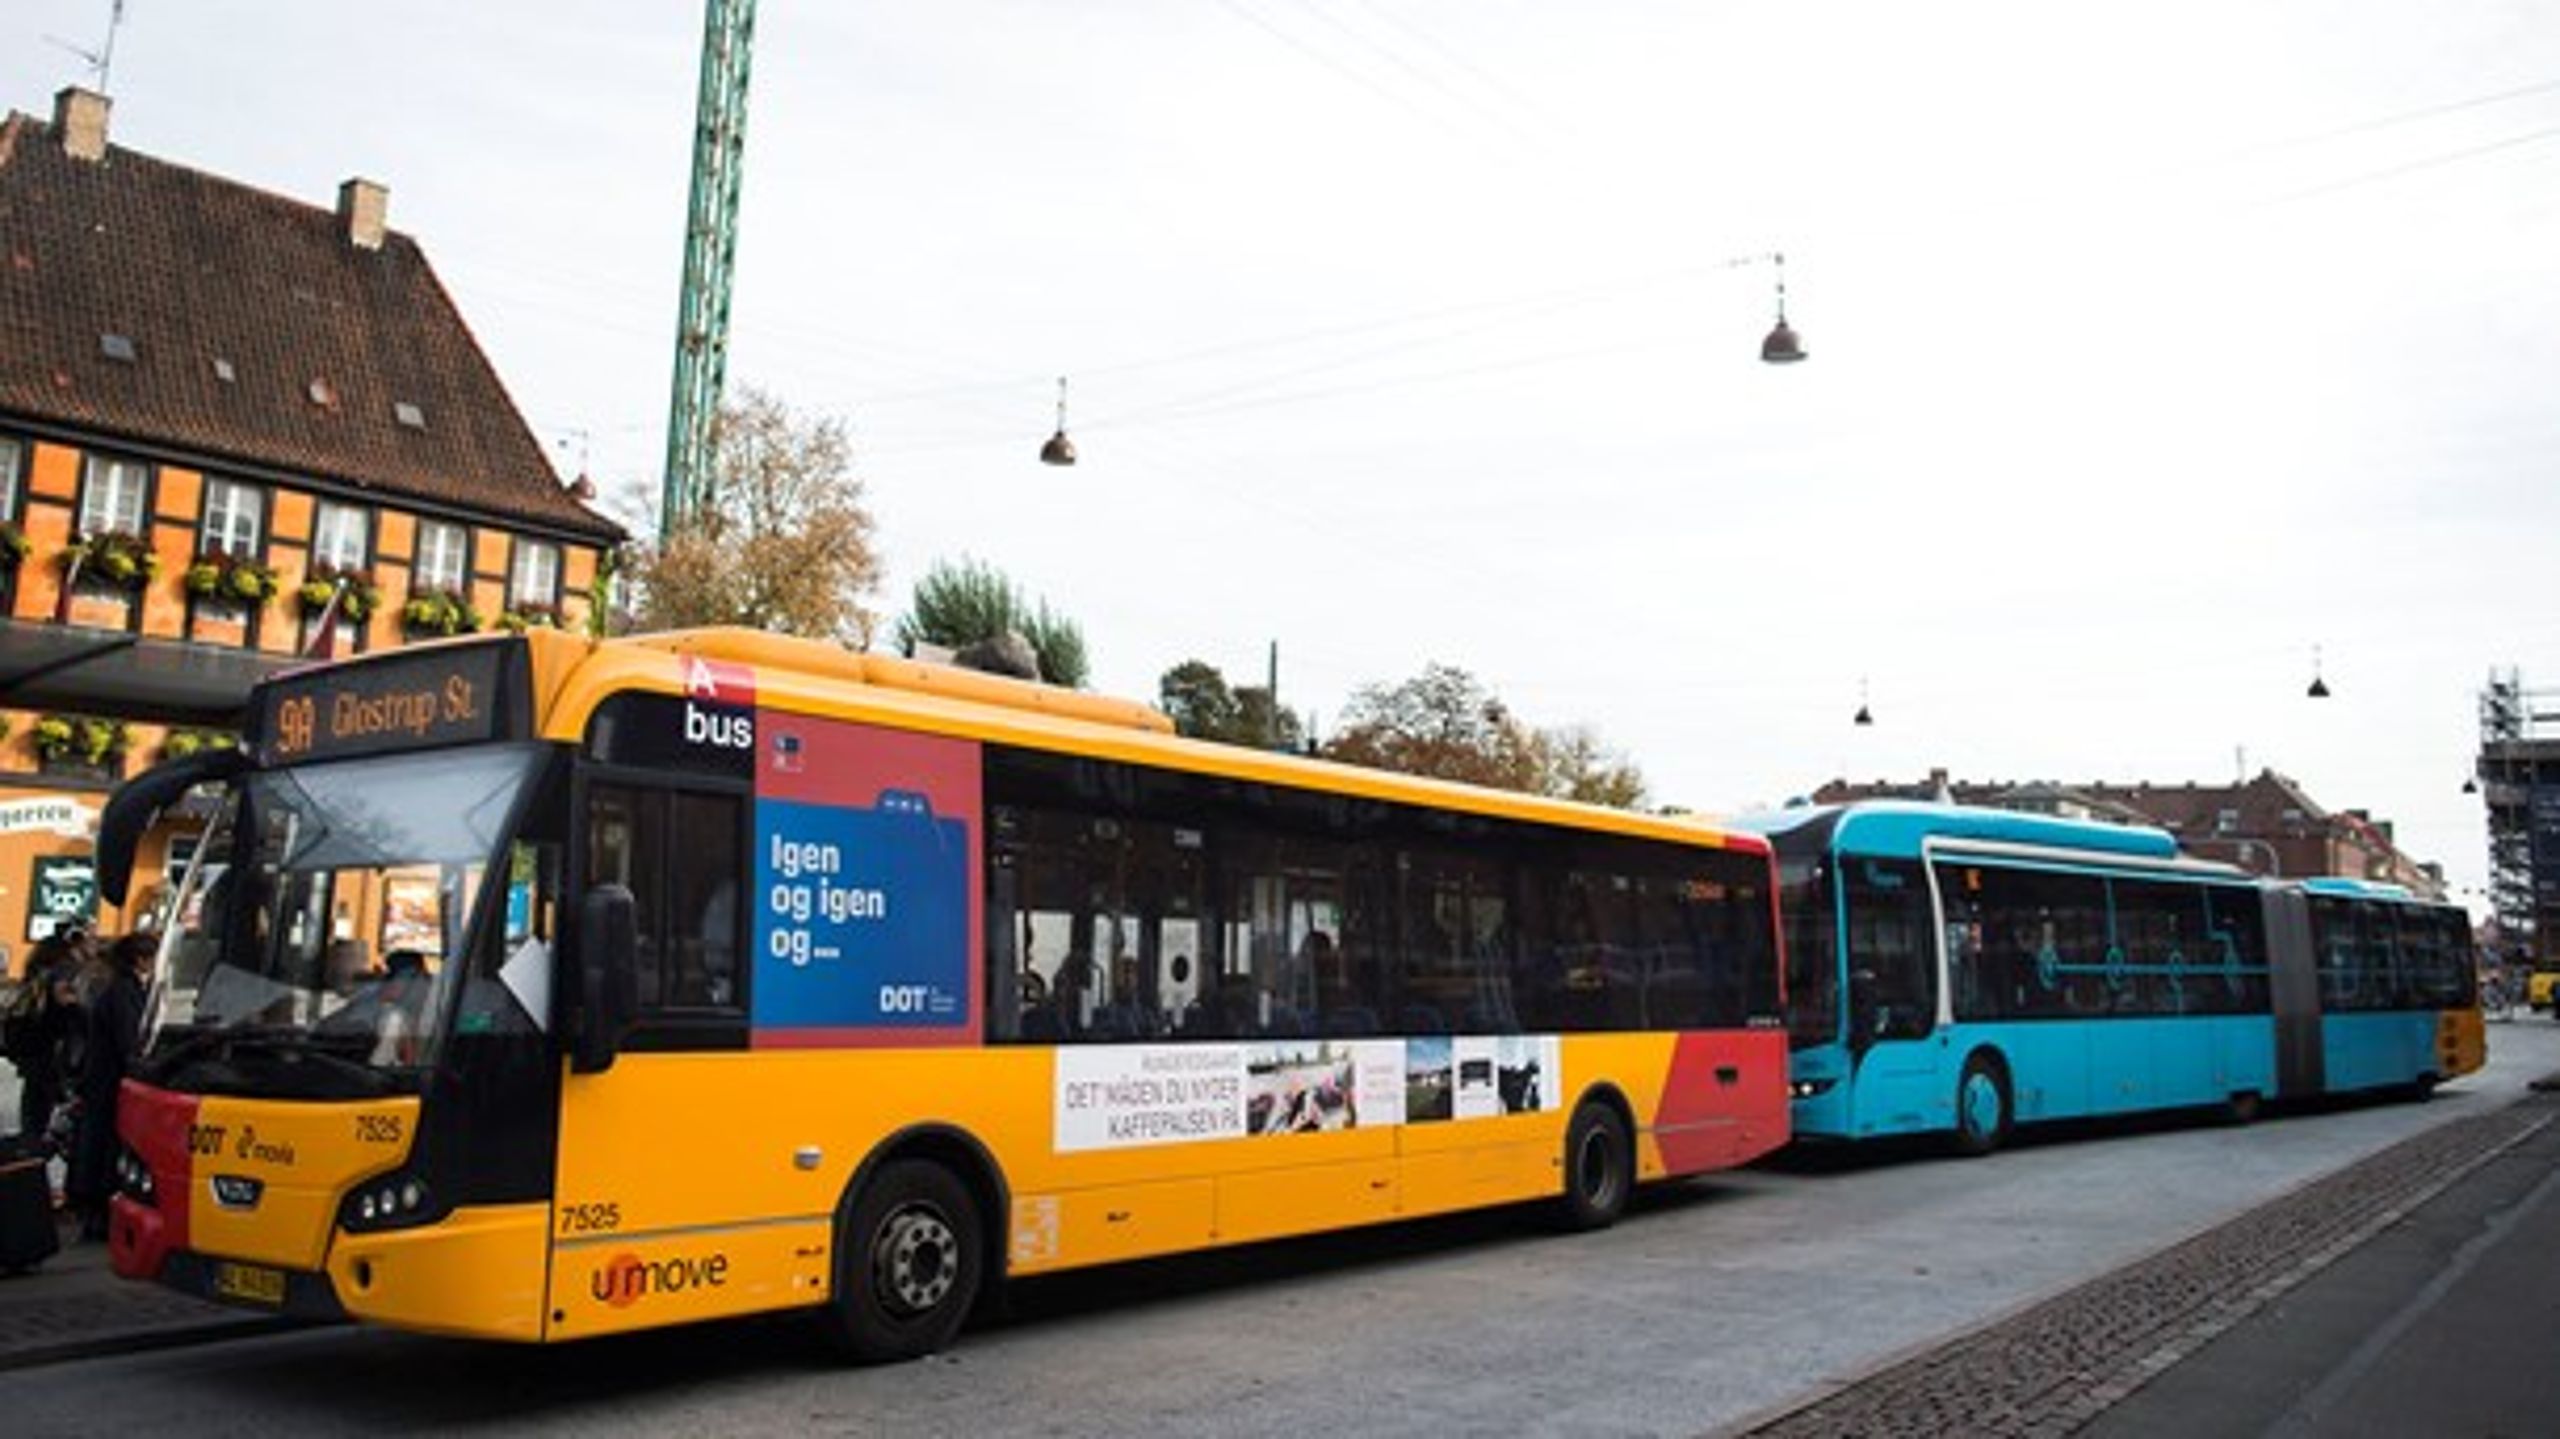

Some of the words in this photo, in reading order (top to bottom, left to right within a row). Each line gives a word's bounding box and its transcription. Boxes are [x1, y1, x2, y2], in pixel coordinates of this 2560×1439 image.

[689, 658, 718, 697] A
[332, 692, 437, 737] Glostrup
[685, 702, 753, 749] bus
[770, 832, 840, 879] Igen
[770, 884, 812, 923] og
[819, 876, 886, 924] igen
[879, 984, 928, 1013] DOT
[561, 1204, 620, 1233] 7525
